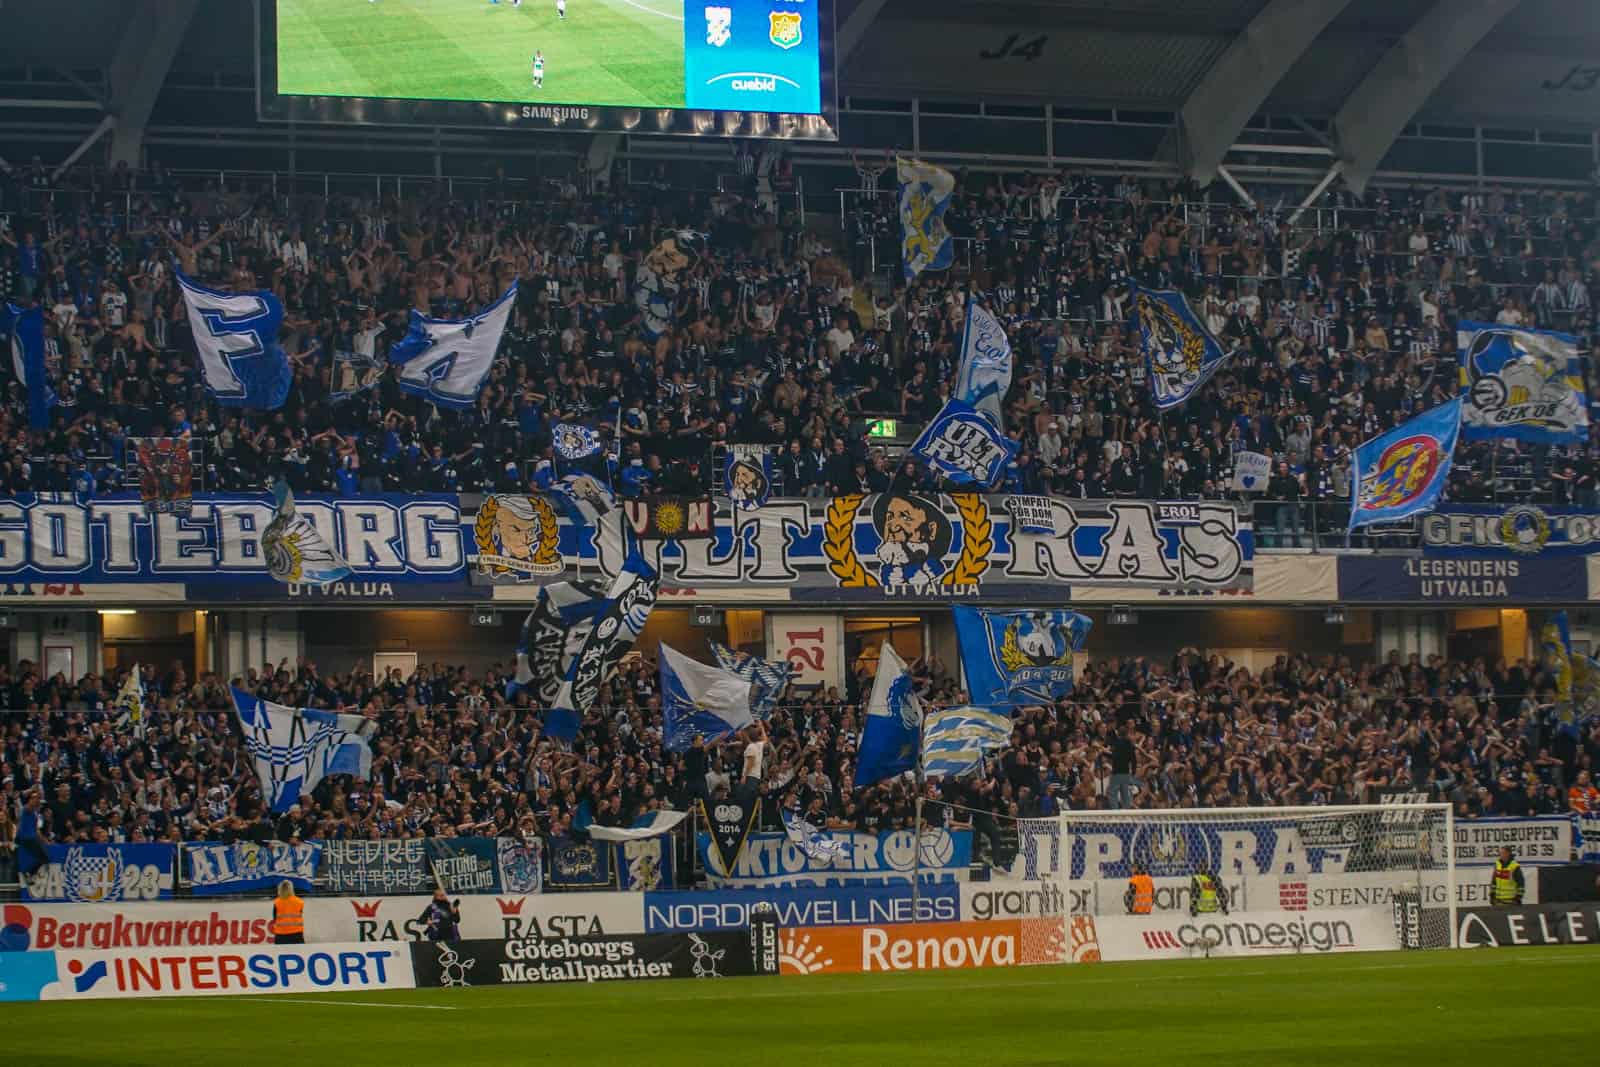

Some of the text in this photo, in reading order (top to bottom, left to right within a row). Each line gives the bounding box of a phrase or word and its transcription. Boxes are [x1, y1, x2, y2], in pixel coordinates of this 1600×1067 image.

[979, 32, 1049, 61] J4
[521, 105, 589, 121] SAMSUNG
[1159, 505, 1199, 518] EROL
[1423, 514, 1502, 546] GFK
[1408, 559, 1520, 577] LEGENDENS
[1421, 579, 1508, 597] UTVALDA
[1436, 826, 1467, 844] SÖD
[1472, 826, 1560, 843] TIFOGRUPPEN
[1441, 847, 1479, 859] SISH:
[450, 871, 494, 891] FEELING
[775, 897, 955, 925] WELLNESS
[356, 919, 422, 942] RAS
[502, 915, 605, 940] RASTA
[1506, 911, 1600, 945] ELE
[504, 937, 635, 962] Göteborgs
[762, 921, 777, 971] SELECT
[862, 927, 1016, 972] Renova
[114, 950, 393, 992] INTERSPORT
[499, 956, 674, 983] Metallpartier
